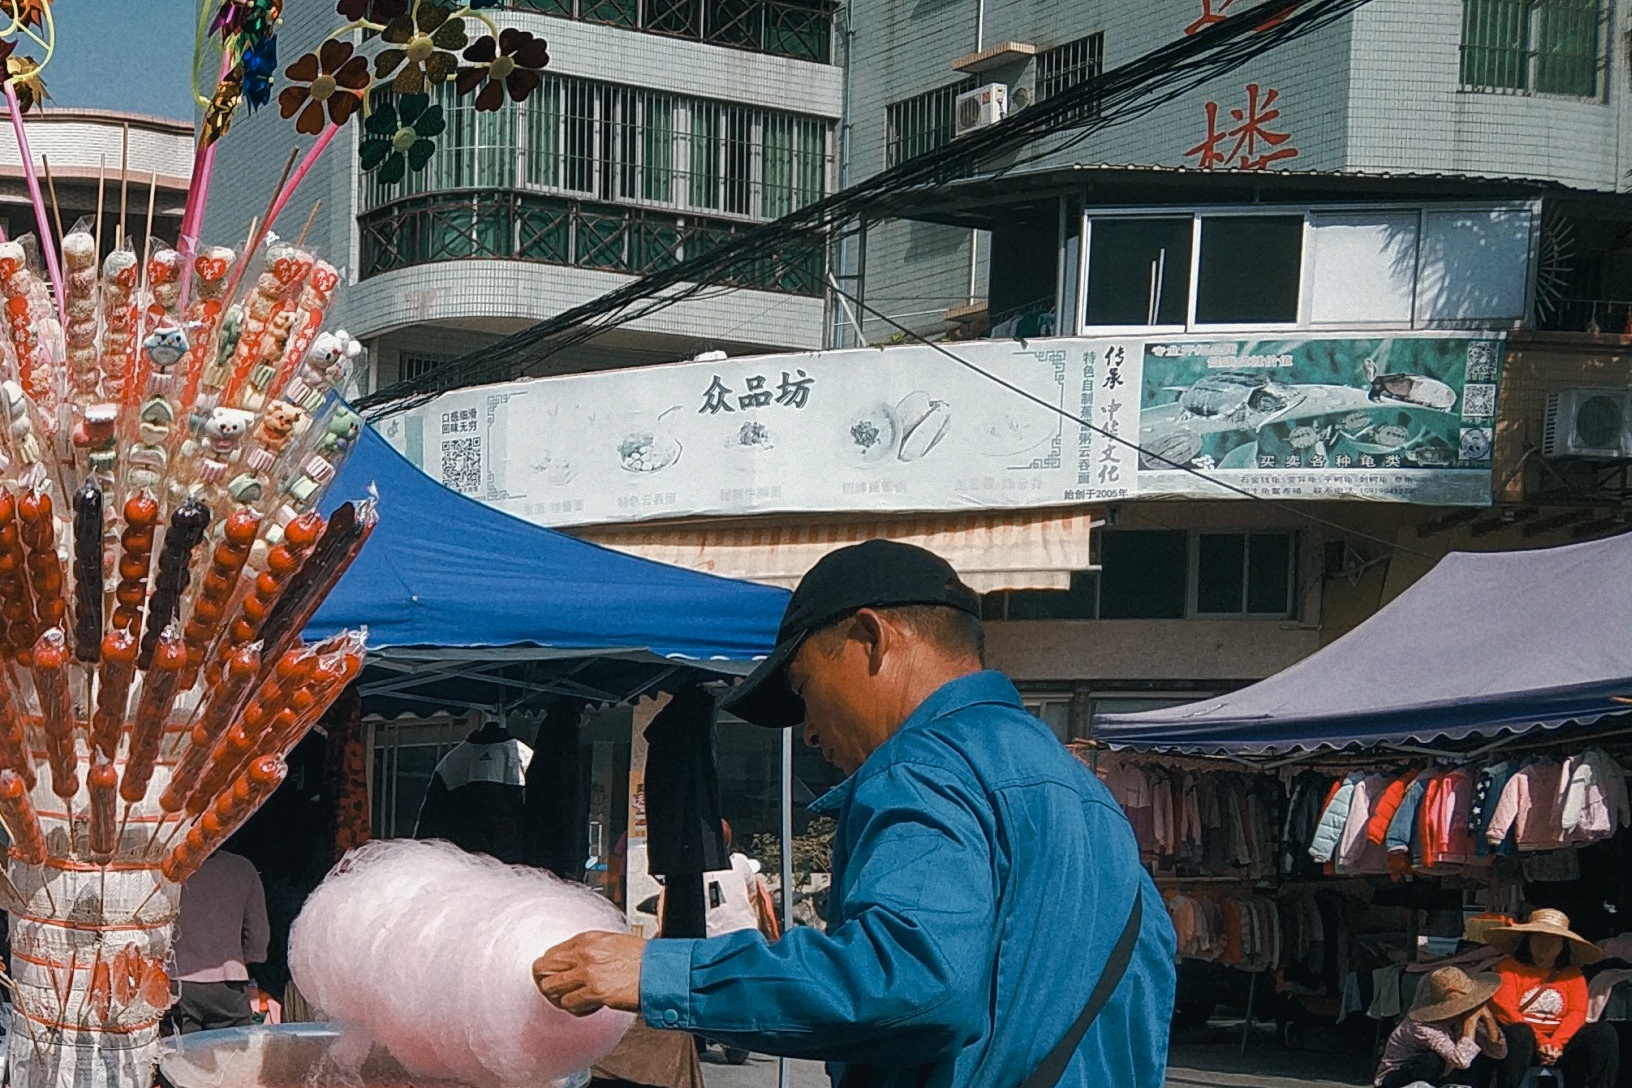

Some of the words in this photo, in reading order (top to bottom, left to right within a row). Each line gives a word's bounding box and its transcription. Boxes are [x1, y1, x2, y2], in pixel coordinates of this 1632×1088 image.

[1102, 345, 1125, 390] 传承
[698, 369, 816, 415] 众品坊
[441, 408, 477, 423] 口感细滑
[441, 422, 477, 435] 回味无穷
[1098, 398, 1122, 484] 中华文化
[1259, 454, 1402, 468] 买卖各种龟类
